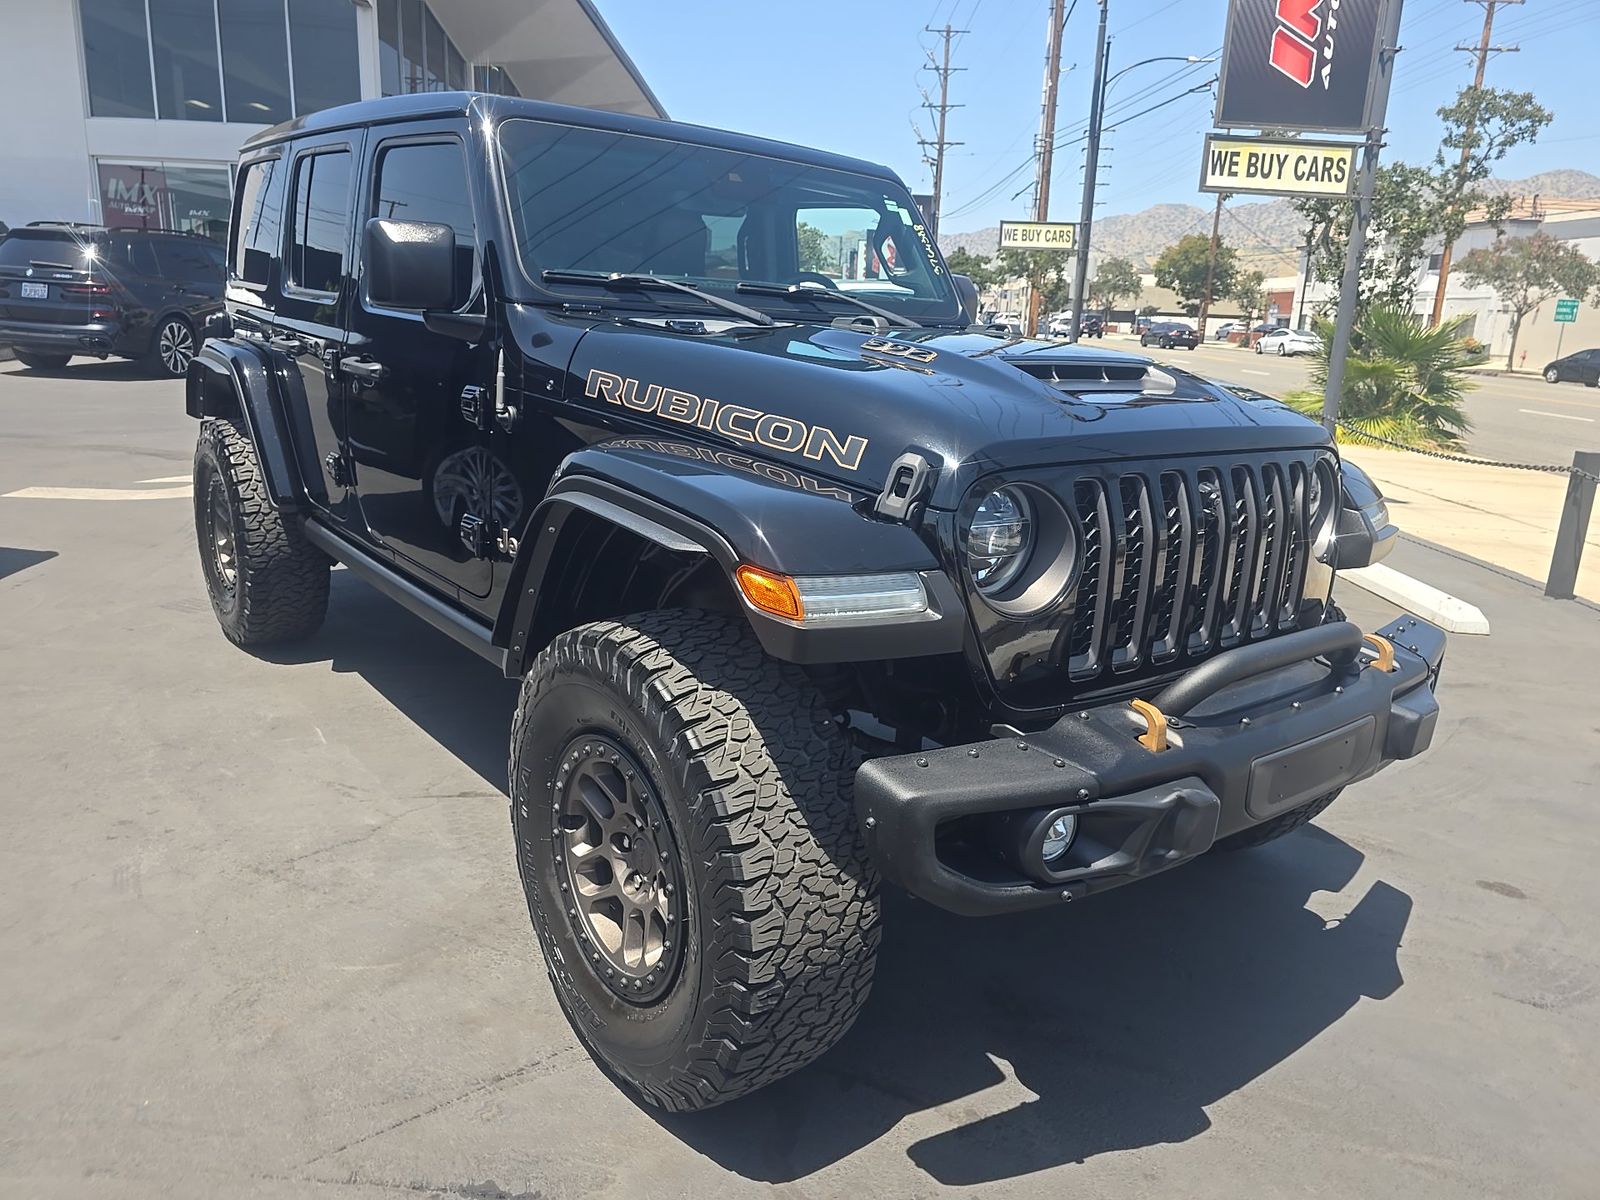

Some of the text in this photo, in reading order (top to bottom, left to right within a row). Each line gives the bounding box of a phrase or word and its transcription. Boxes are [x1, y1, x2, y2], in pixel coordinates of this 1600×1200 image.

[1210, 149, 1347, 183] WE BUY CARS
[107, 178, 159, 206] IMX
[1003, 227, 1072, 243] WE BUY CARS
[585, 368, 869, 471] RUBICON
